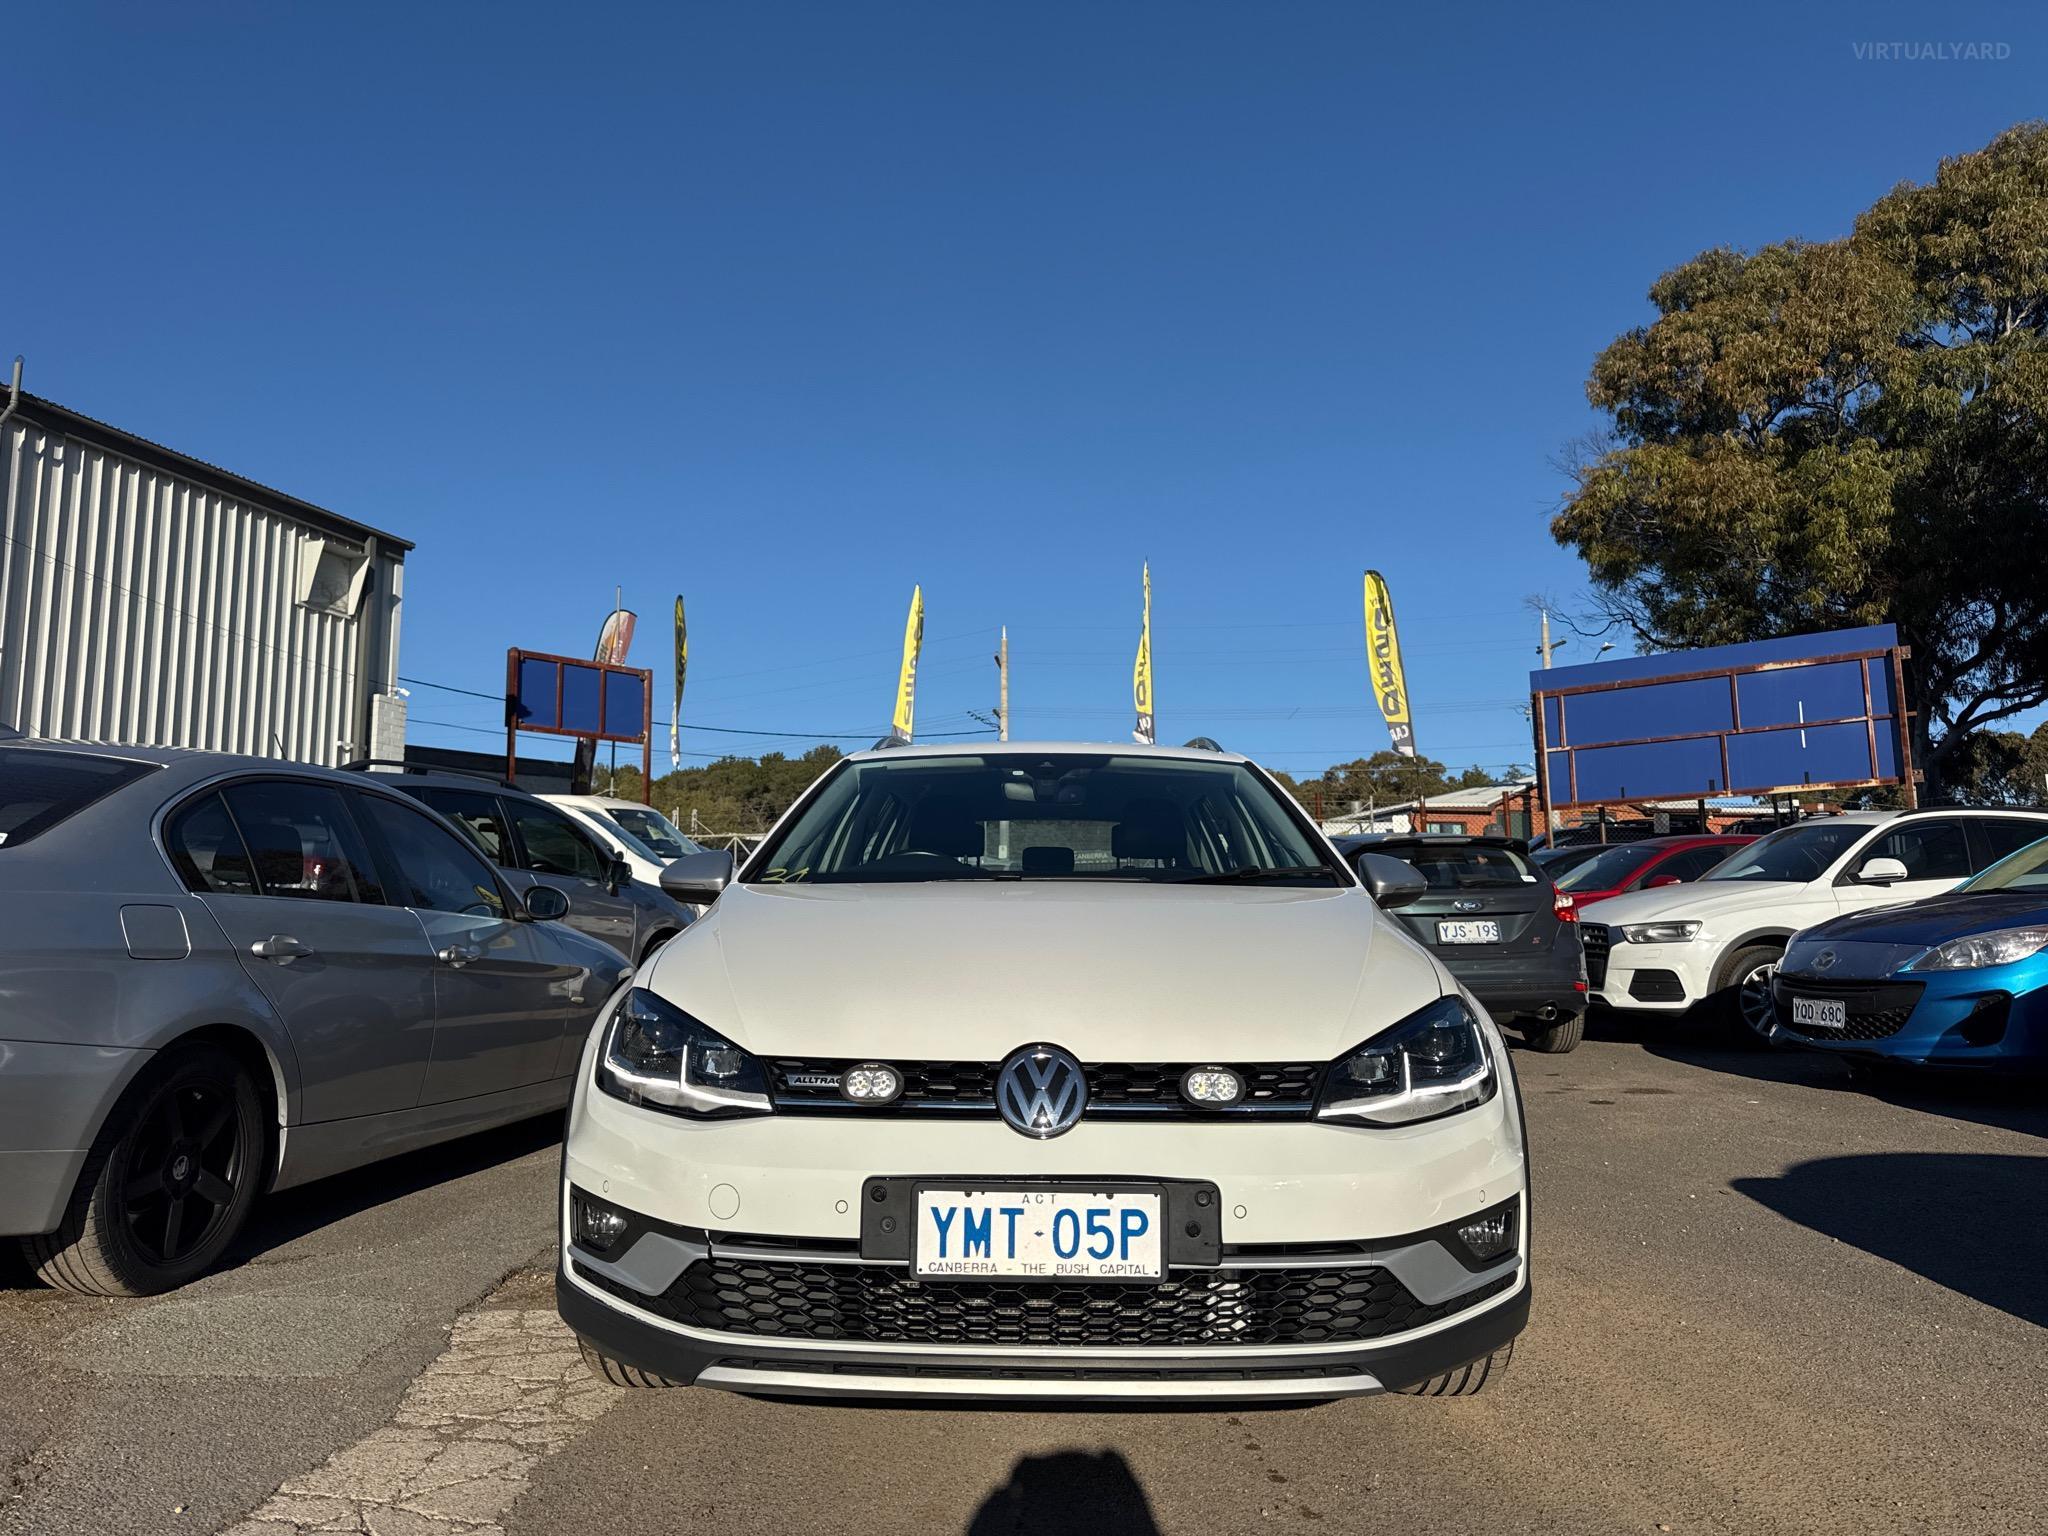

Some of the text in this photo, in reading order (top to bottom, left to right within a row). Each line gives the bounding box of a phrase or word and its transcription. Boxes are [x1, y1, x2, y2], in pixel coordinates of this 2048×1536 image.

[1441, 924, 1467, 938] YJS
[1821, 1006, 1842, 1023] 68C
[1022, 1193, 1056, 1205] ACT
[930, 1206, 1149, 1261] YMT 05P
[928, 1262, 998, 1274] CANBERRA
[1021, 1263, 1047, 1275] THE
[1056, 1263, 1090, 1275] BUSH
[1099, 1264, 1149, 1276] CAPITAL
